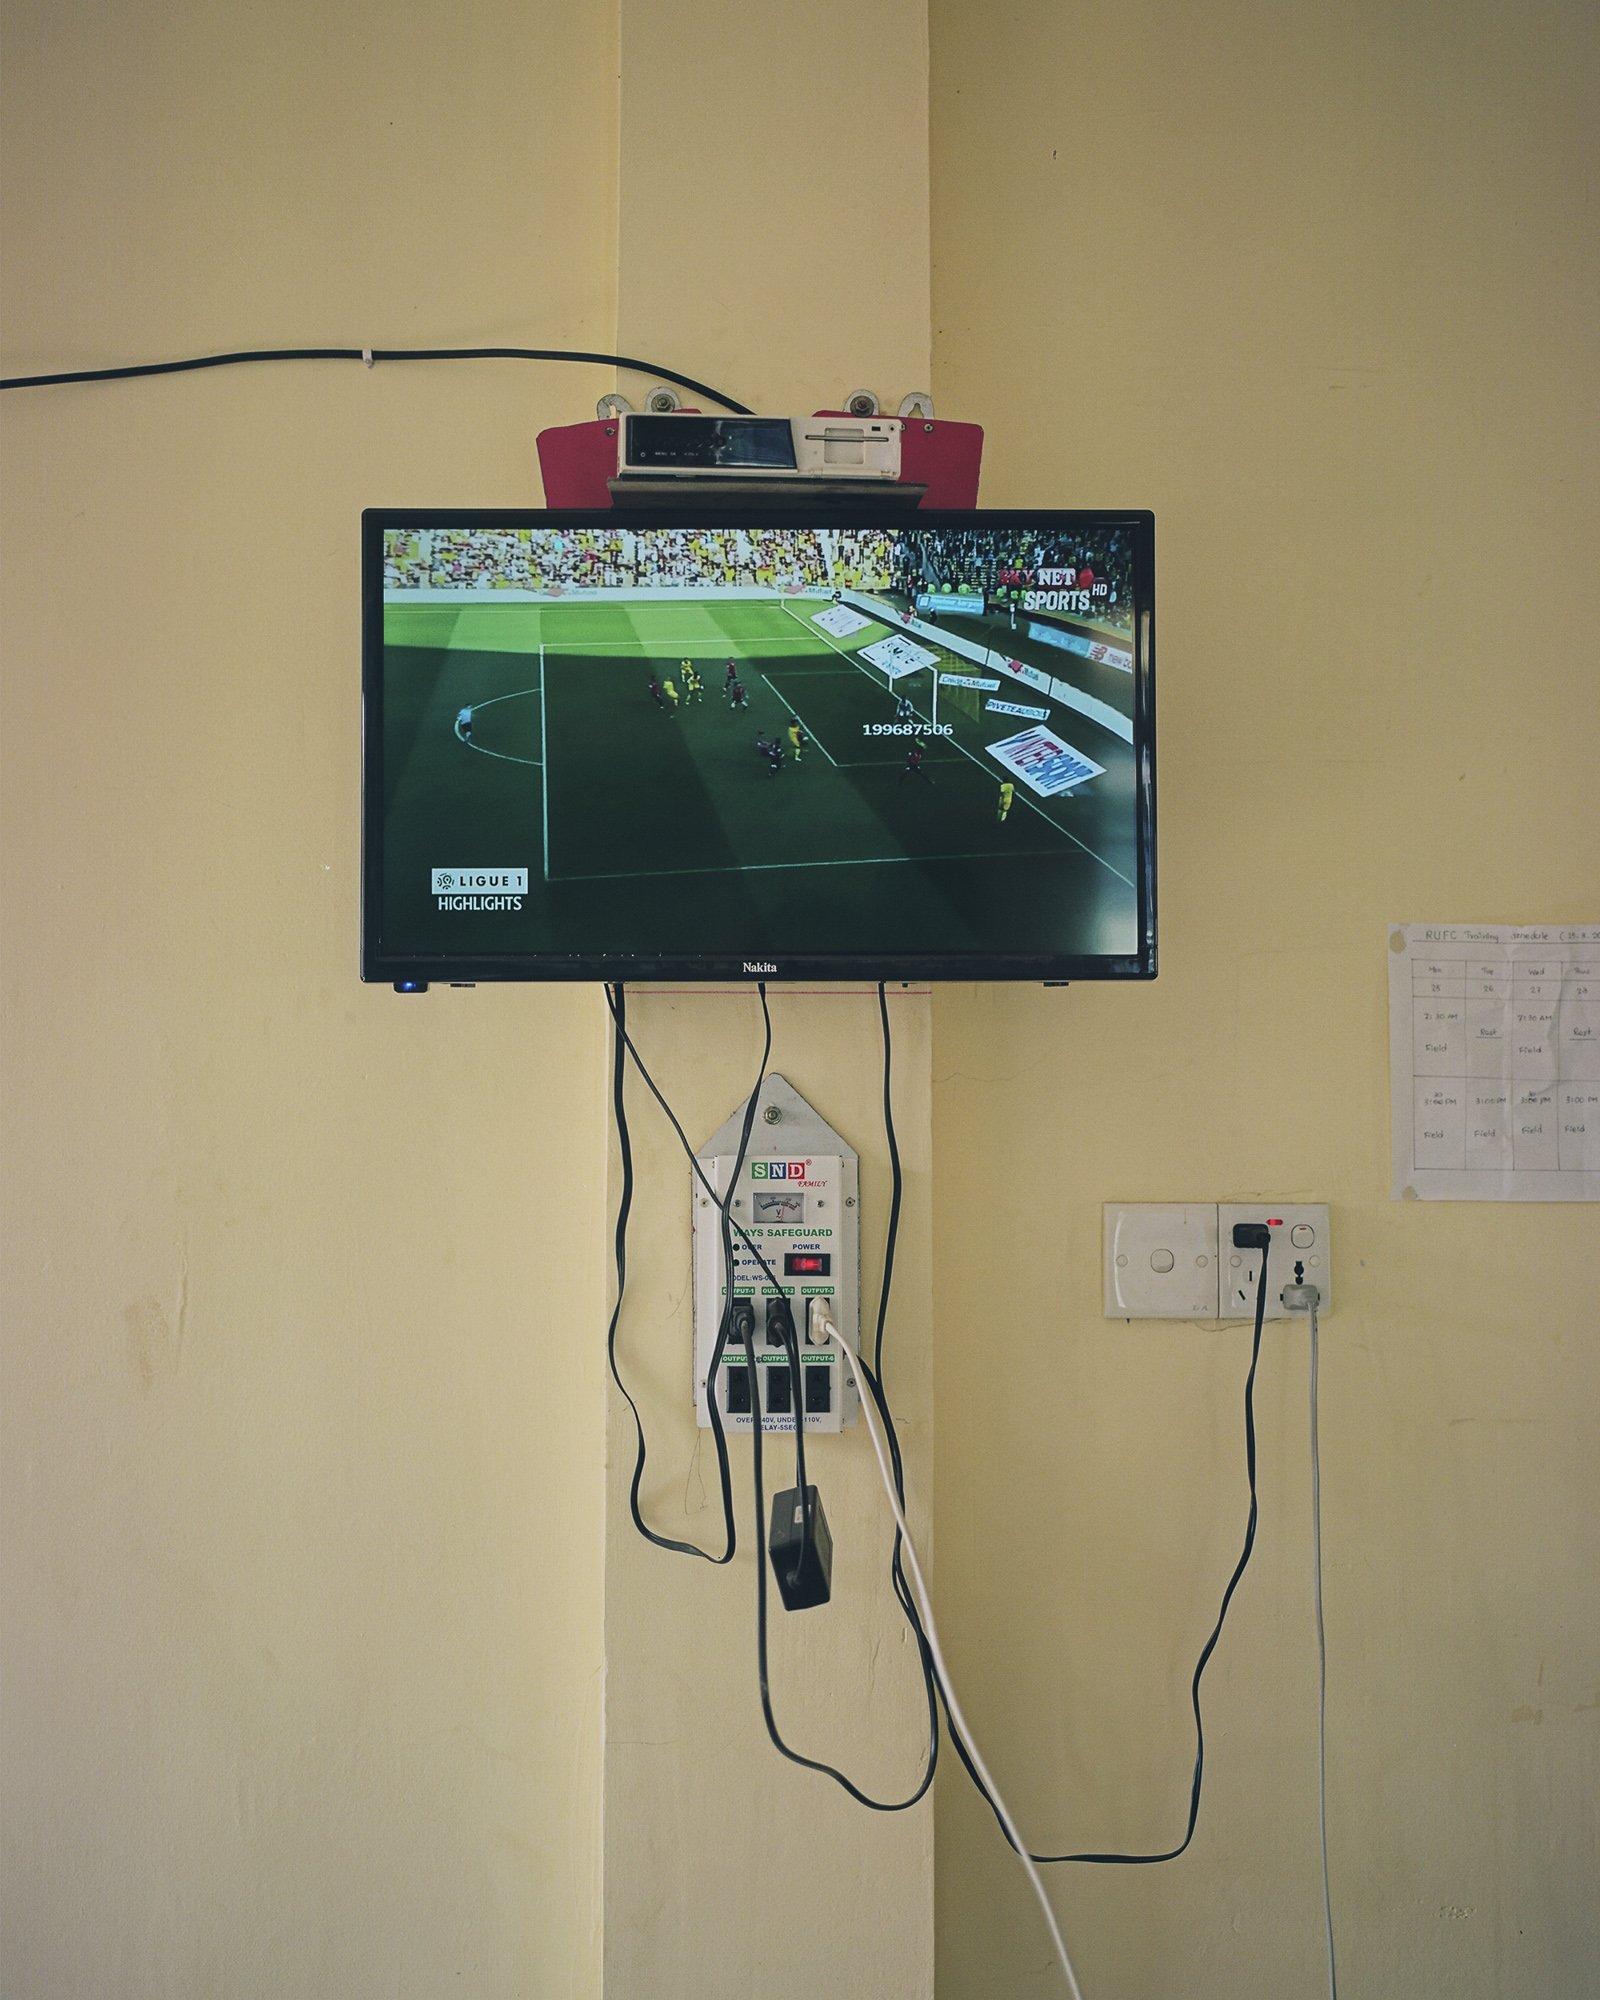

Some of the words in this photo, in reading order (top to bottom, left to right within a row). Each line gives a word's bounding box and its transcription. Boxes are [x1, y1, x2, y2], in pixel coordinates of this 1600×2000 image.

[1037, 568, 1076, 586] NET
[1023, 590, 1091, 611] SPORTS
[1092, 583, 1108, 596] HD
[863, 724, 954, 736] 199687506
[460, 876, 509, 887] LIGUE
[516, 876, 522, 887] 1
[438, 896, 522, 911] HIGHLIGHTS
[1425, 930, 1457, 940] RUFC
[742, 962, 778, 973] Nakita
[753, 1163, 804, 1178] SND
[767, 1228, 833, 1237] SAFEGUARD
